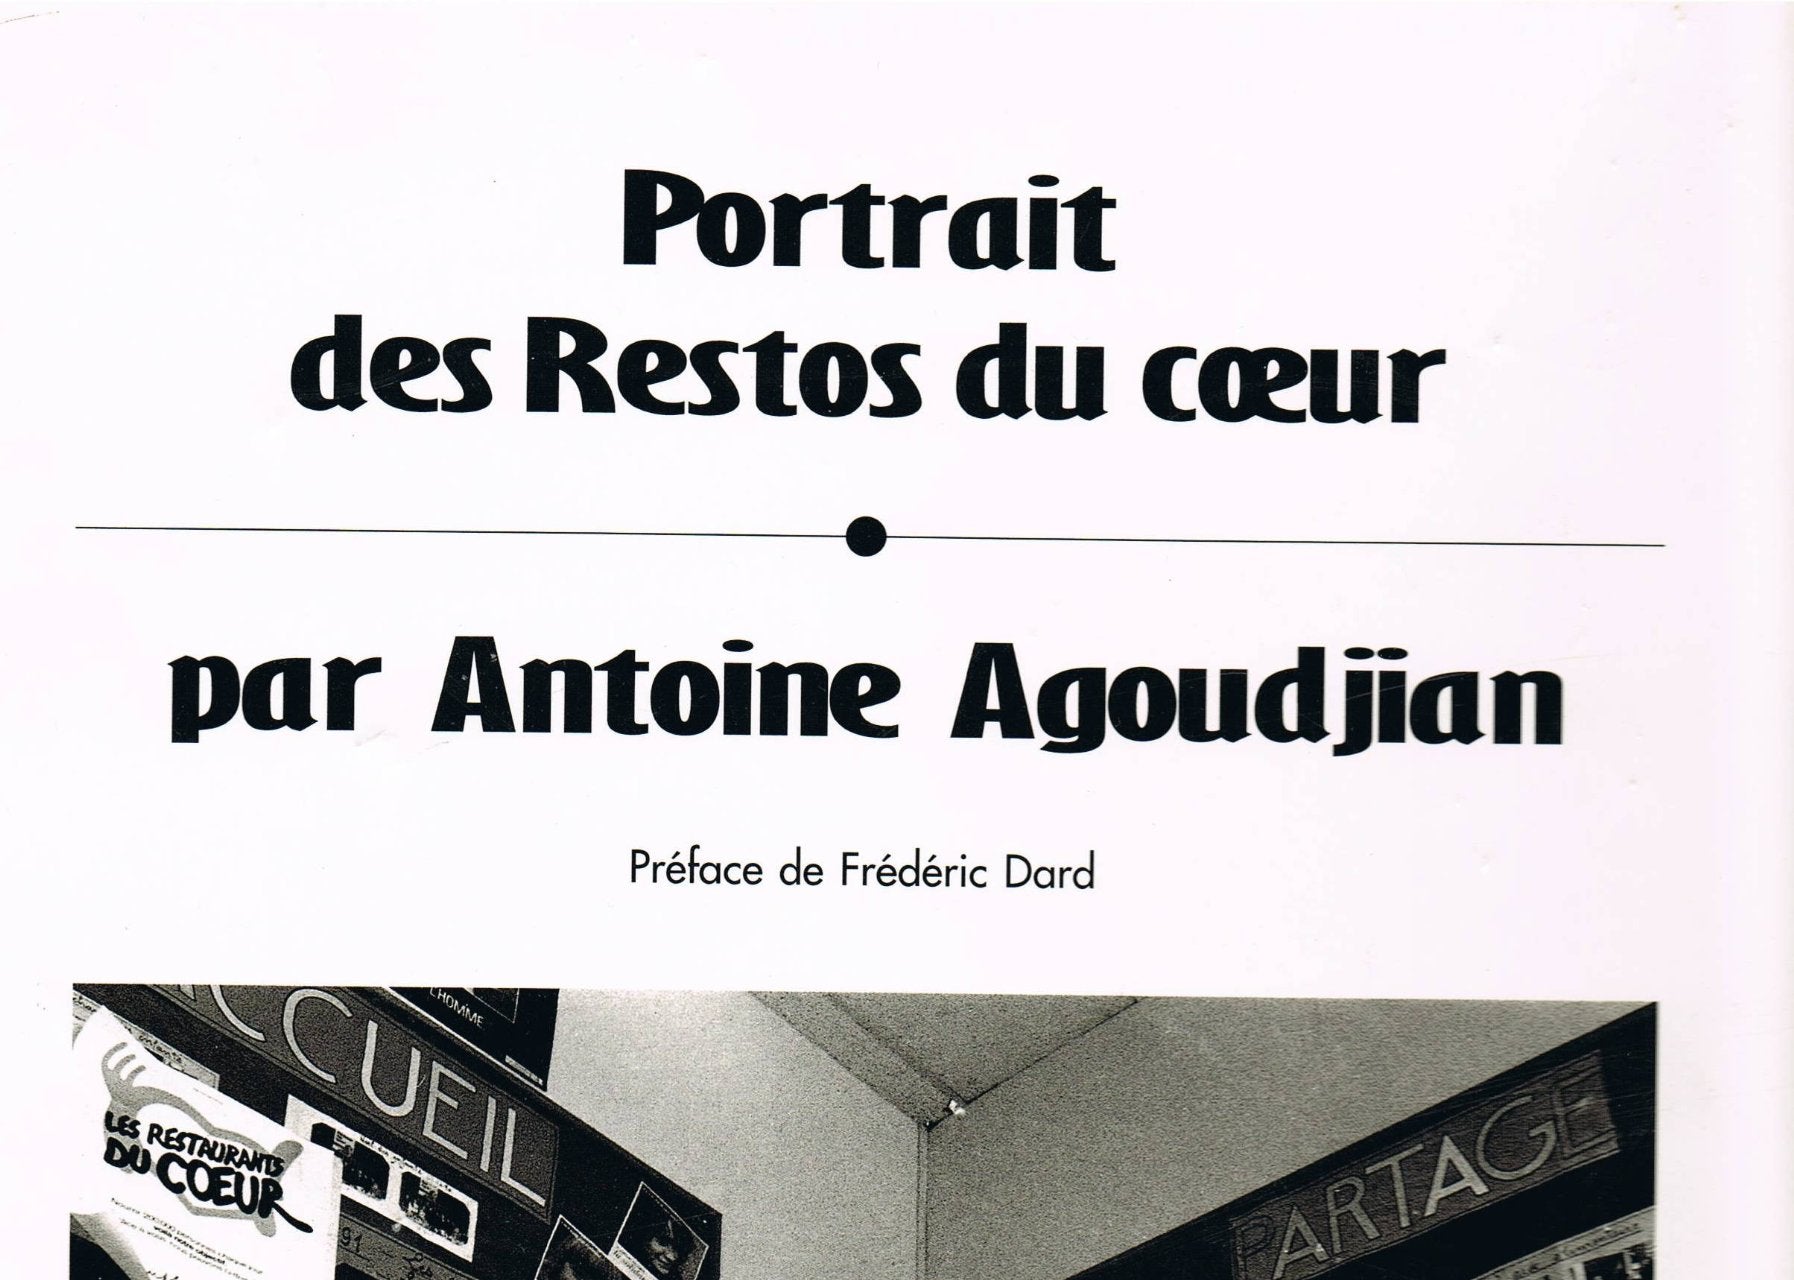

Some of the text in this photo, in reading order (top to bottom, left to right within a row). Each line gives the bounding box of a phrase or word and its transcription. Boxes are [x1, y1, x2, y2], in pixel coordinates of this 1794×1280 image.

[623, 169, 1116, 272] Portrait
[291, 314, 1446, 424] des Restos du cœur
[168, 636, 1563, 756] par Antoine Agoudjian
[631, 844, 1094, 889] Préface de Frédéric Dard
[105, 1111, 285, 1177] LES RESTAURANTS
[178, 984, 546, 1207] CCUEIL
[104, 1137, 151, 1174] DU
